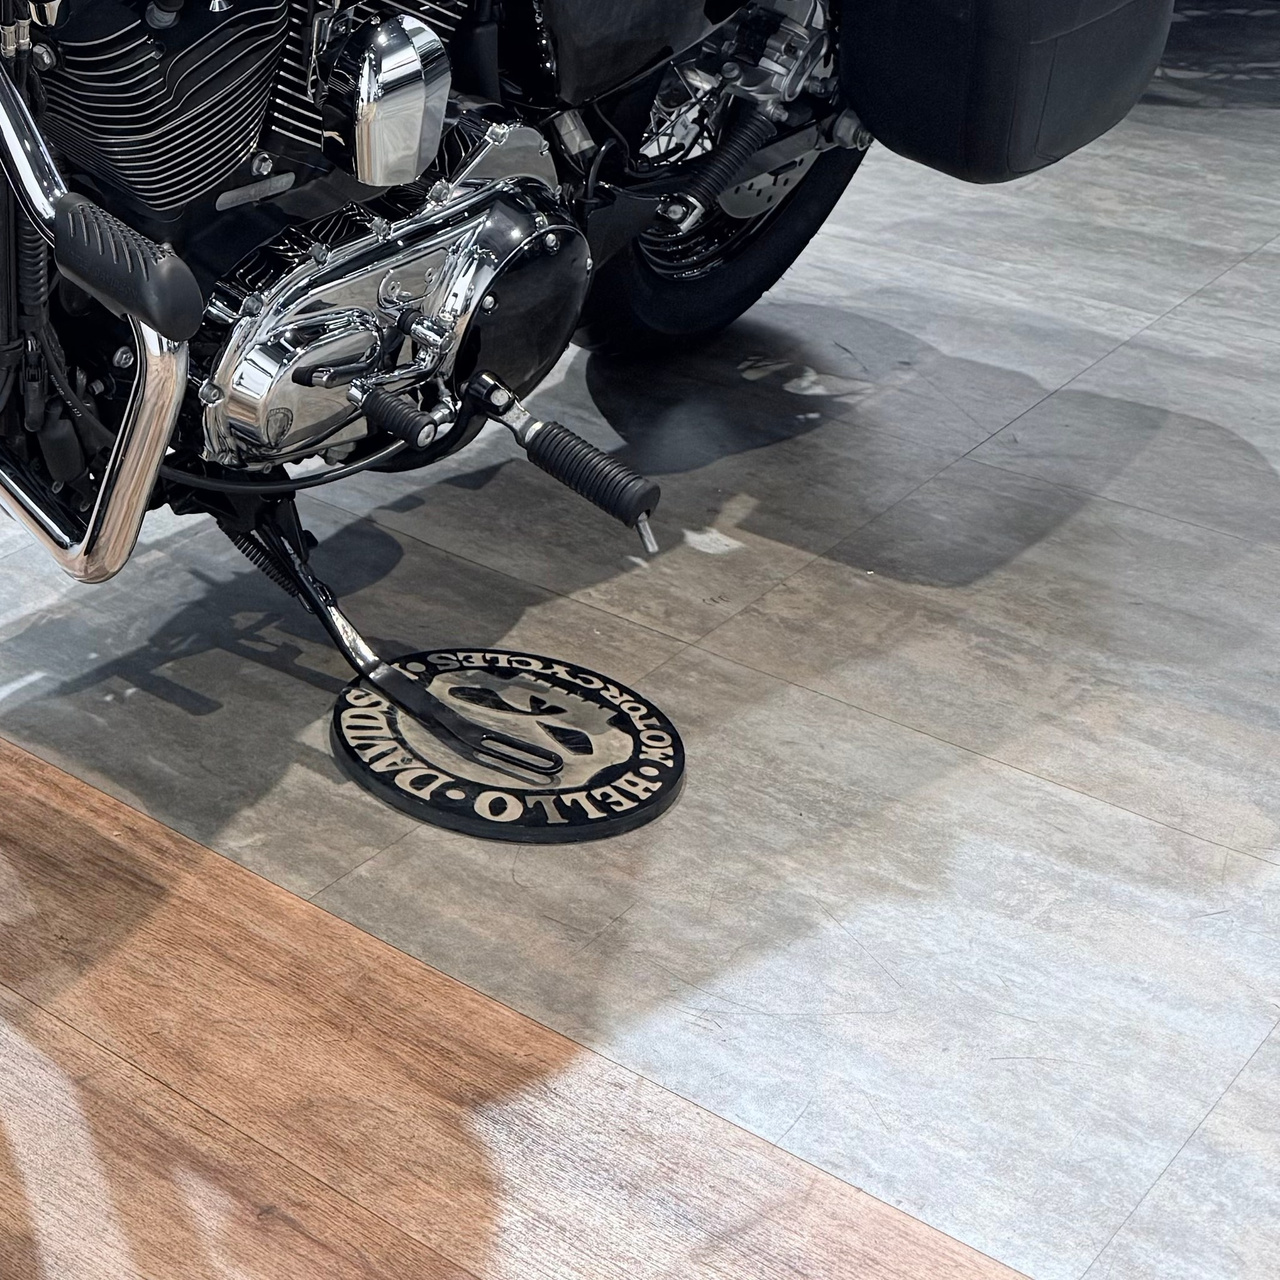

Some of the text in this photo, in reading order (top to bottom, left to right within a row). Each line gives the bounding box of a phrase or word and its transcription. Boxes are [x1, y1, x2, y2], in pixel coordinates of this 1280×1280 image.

[340, 651, 674, 824] HELLO DAVIDS MOTORCYCLES
